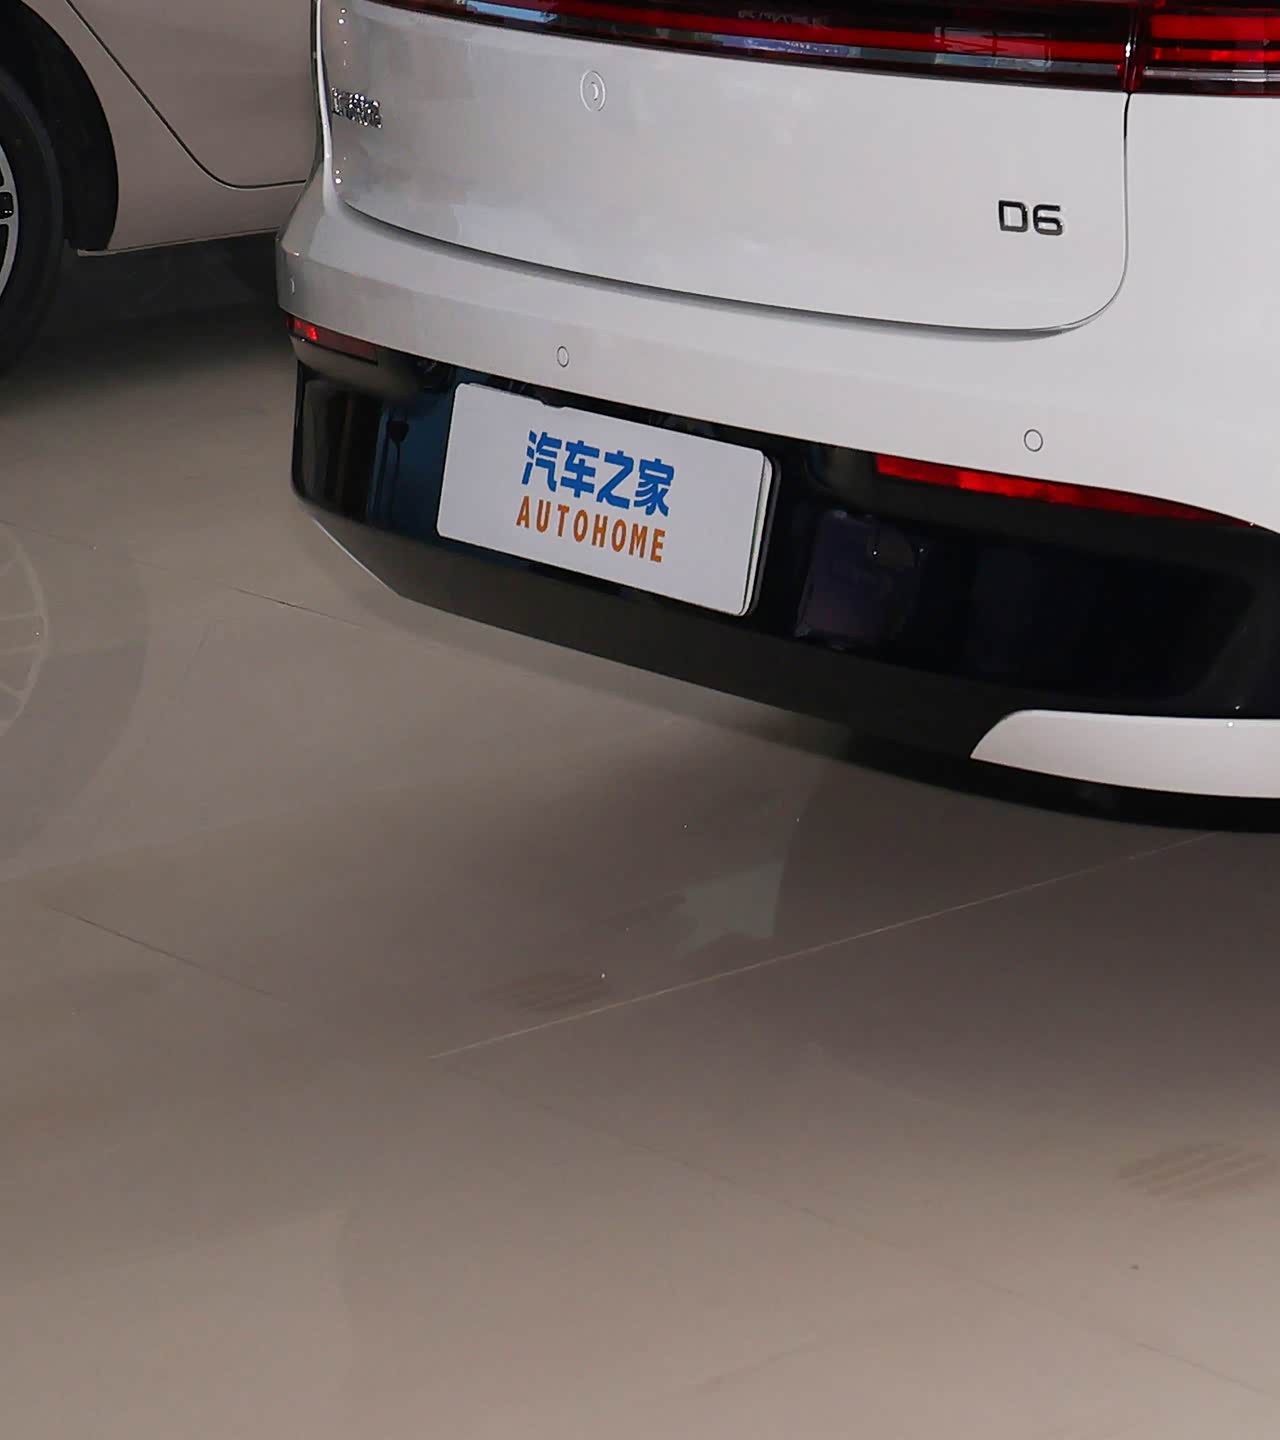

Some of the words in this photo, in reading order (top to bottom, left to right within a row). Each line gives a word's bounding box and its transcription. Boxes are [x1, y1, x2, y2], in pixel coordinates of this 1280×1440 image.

[998, 200, 1064, 236] D6
[521, 430, 675, 517] 汽车之家
[516, 495, 666, 563] AUTOHOME
